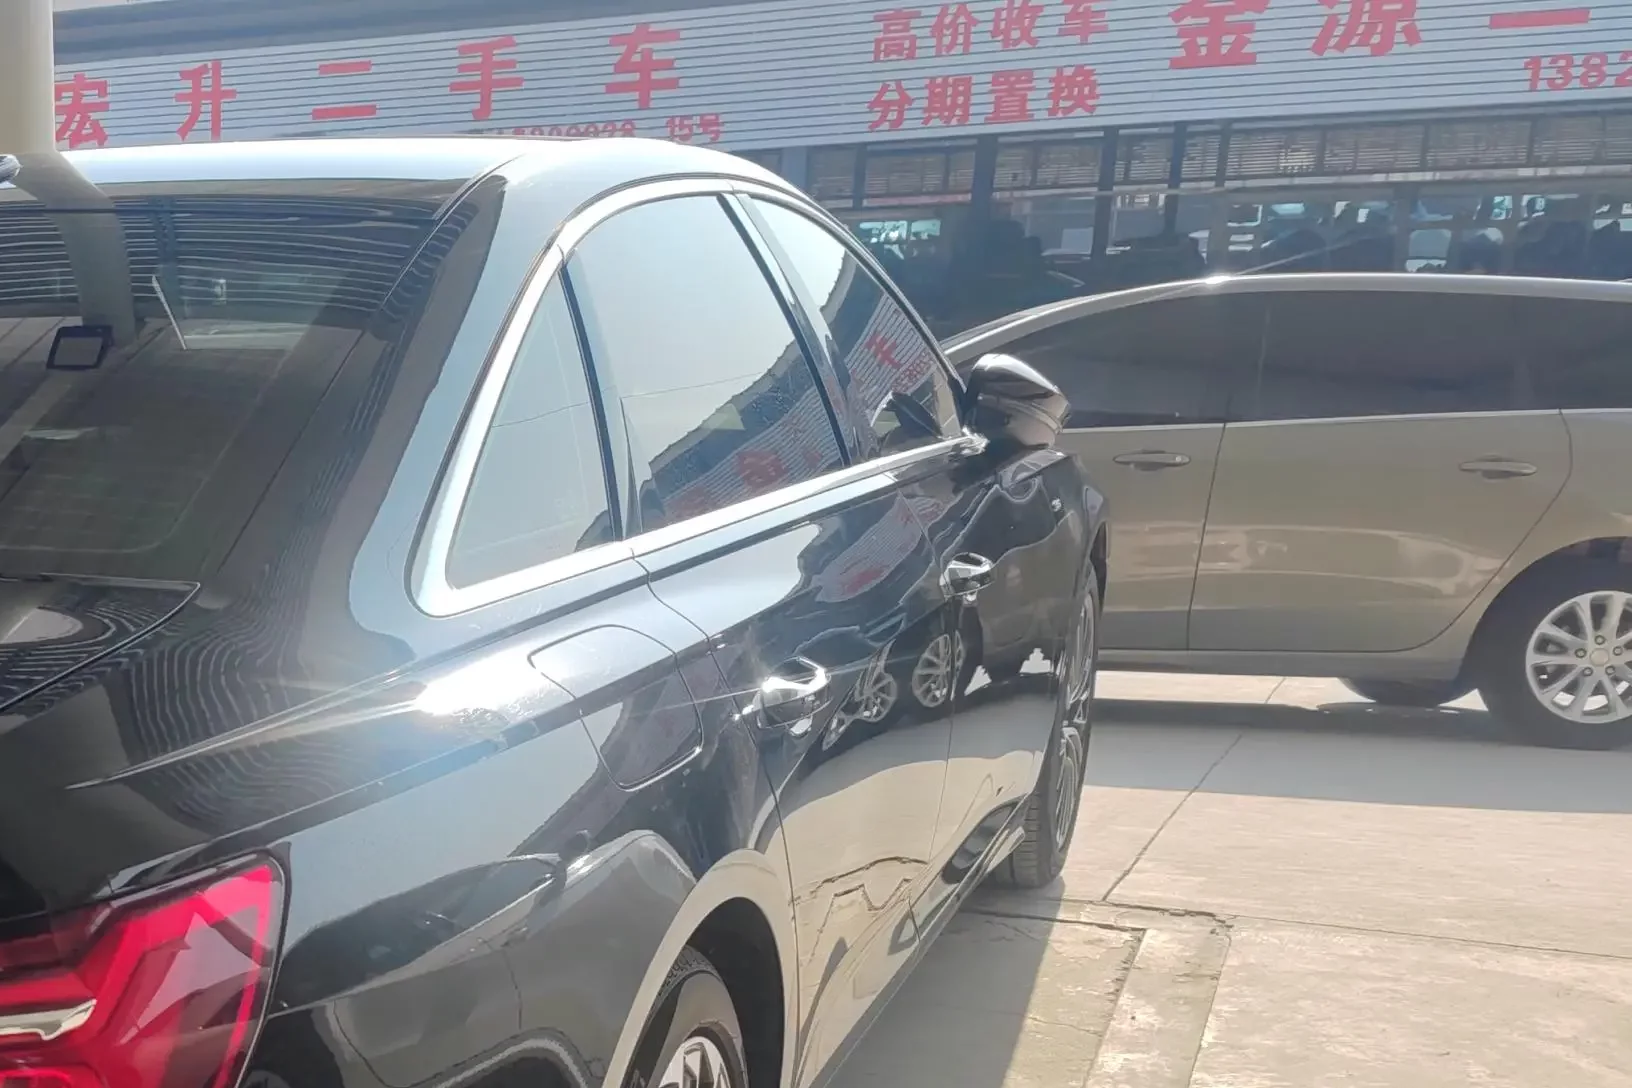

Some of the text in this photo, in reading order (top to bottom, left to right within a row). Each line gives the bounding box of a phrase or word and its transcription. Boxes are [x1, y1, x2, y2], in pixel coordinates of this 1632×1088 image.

[871, 0, 1109, 63] 高价收车
[54, 22, 681, 149] 宏升二手车
[867, 64, 1101, 132] 分期置换
